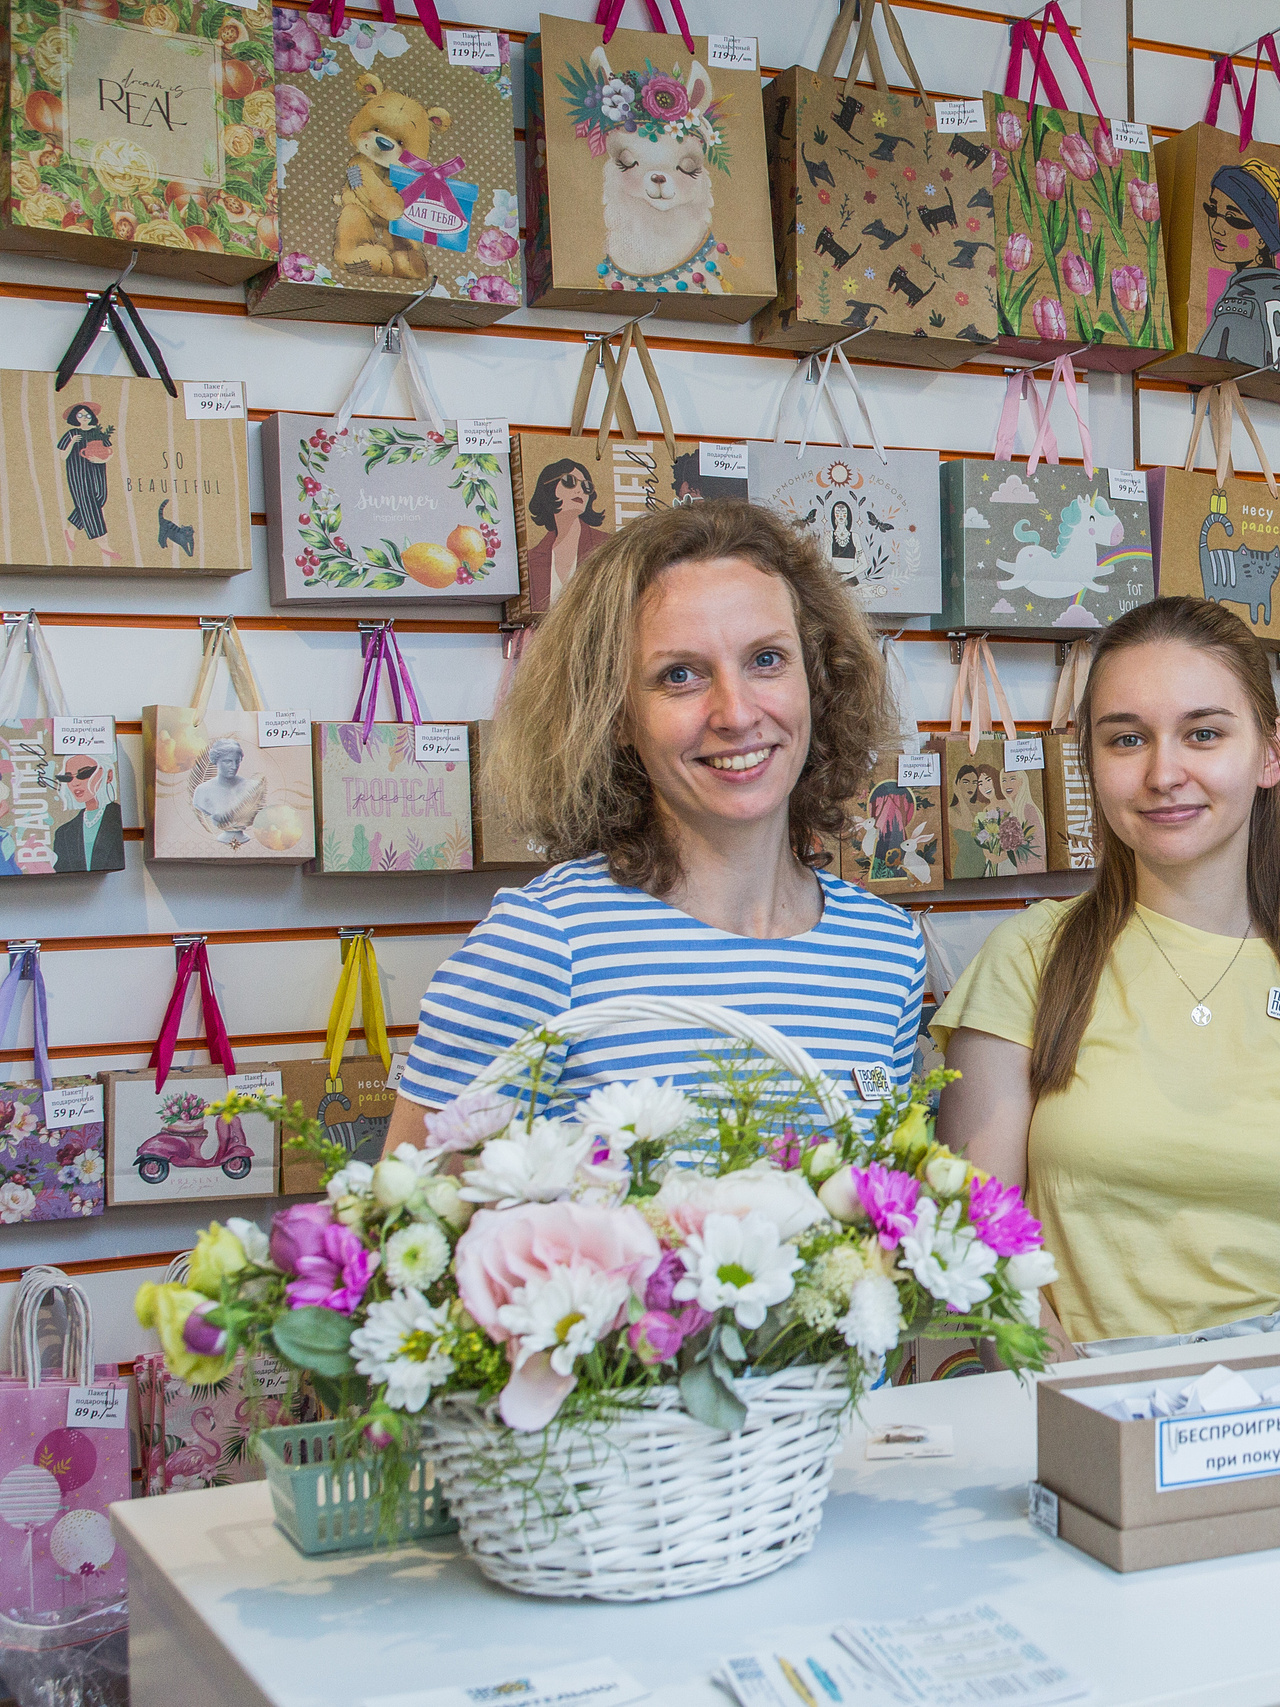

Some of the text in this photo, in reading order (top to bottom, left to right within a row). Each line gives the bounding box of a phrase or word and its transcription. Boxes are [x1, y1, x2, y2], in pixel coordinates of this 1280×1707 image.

[452, 48, 469, 57] 119
[712, 51, 729, 59] 119
[121, 68, 164, 89] dream
[98, 78, 188, 131] REAL
[940, 117, 955, 125] 119
[1115, 134, 1128, 142] 119
[408, 205, 457, 226] ДЛЯ ТЕБЯ!
[200, 401, 213, 409] 99
[465, 436, 477, 444] 99
[162, 451, 184, 470] SO
[126, 477, 221, 495] BEAUTIFUL
[767, 470, 814, 504] ГАРМОНИЯ
[1118, 484, 1127, 492] 99
[353, 488, 439, 511] Summer
[371, 513, 421, 523] inspiration
[1242, 504, 1274, 523] несу
[1127, 579, 1143, 596] for
[1118, 599, 1139, 615] you
[62, 735, 76, 744] 69
[266, 729, 279, 737] 69
[422, 744, 435, 752] 69
[902, 770, 912, 778] 59
[9, 731, 52, 864] BEAUTIFUL
[342, 776, 452, 818] TROPICAL
[352, 787, 443, 811] present
[857, 1069, 876, 1081] ТВОЯ
[358, 1077, 387, 1092] несу
[358, 1093, 395, 1107] радос
[53, 1109, 66, 1119] 59
[74, 1407, 89, 1417] 89
[1206, 1456, 1237, 1473] при
